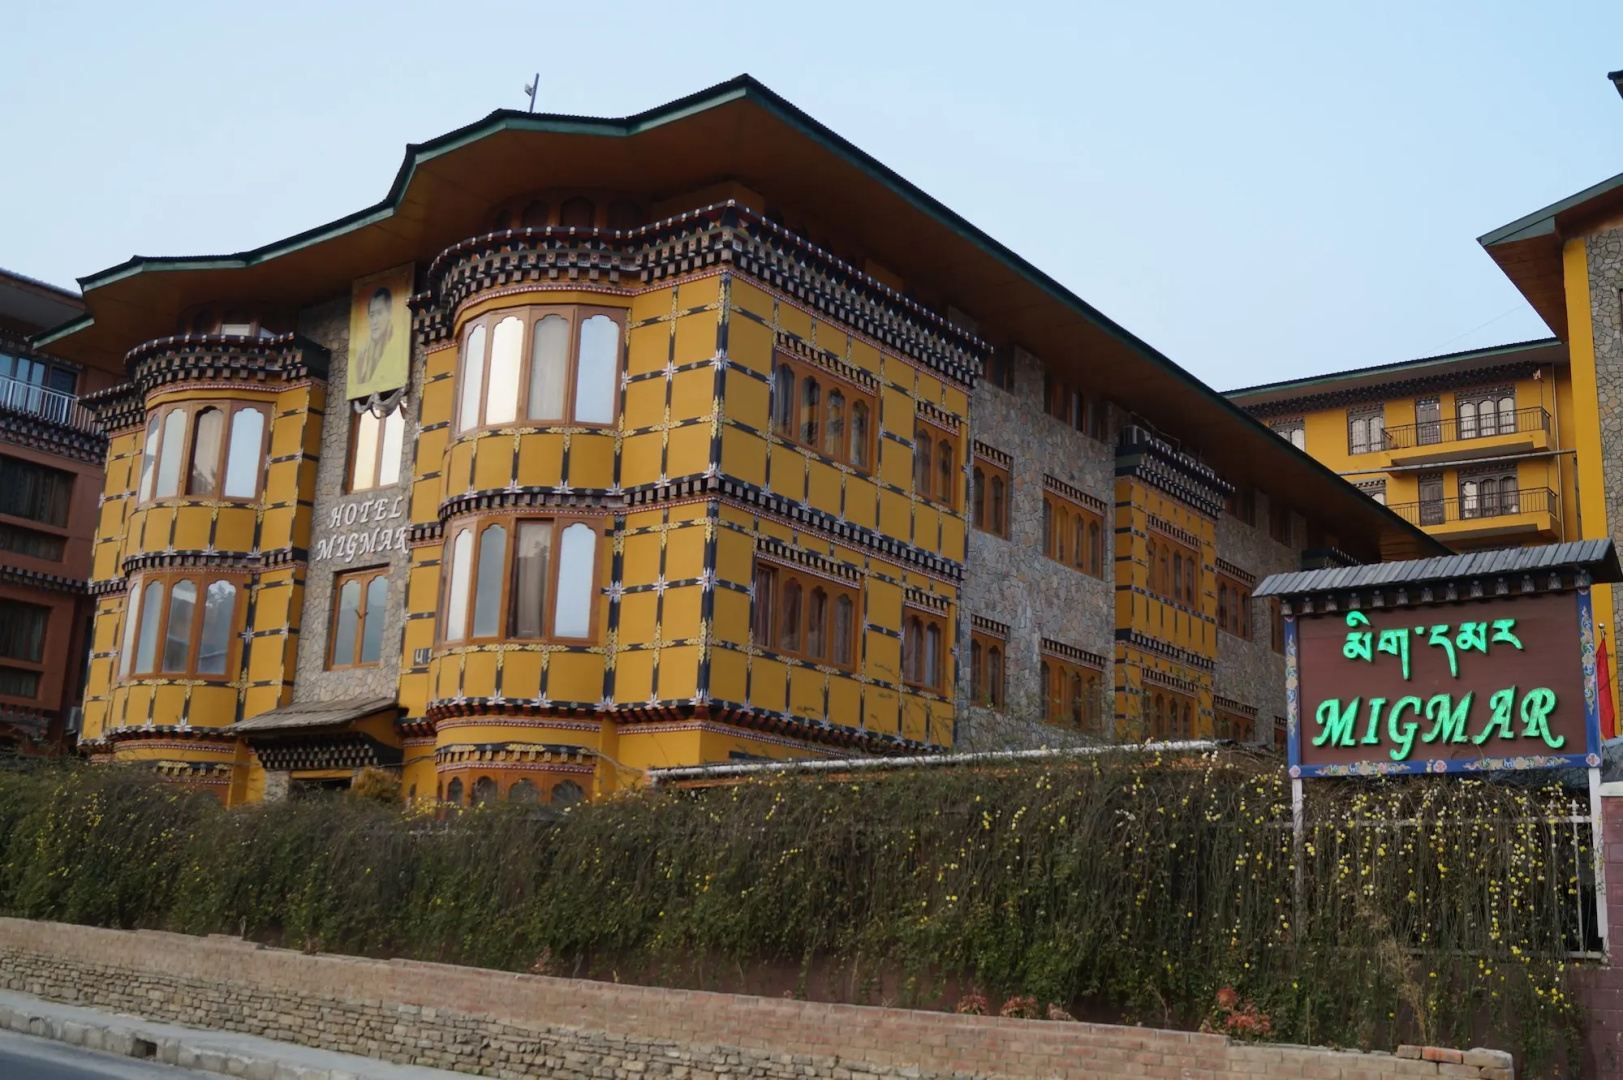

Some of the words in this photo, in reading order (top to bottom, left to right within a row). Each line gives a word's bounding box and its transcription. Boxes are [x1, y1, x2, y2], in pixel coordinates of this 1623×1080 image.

[329, 496, 404, 529] HOTEL
[316, 526, 409, 563] MIGMAR
[1312, 685, 1566, 761] MIGMAR
